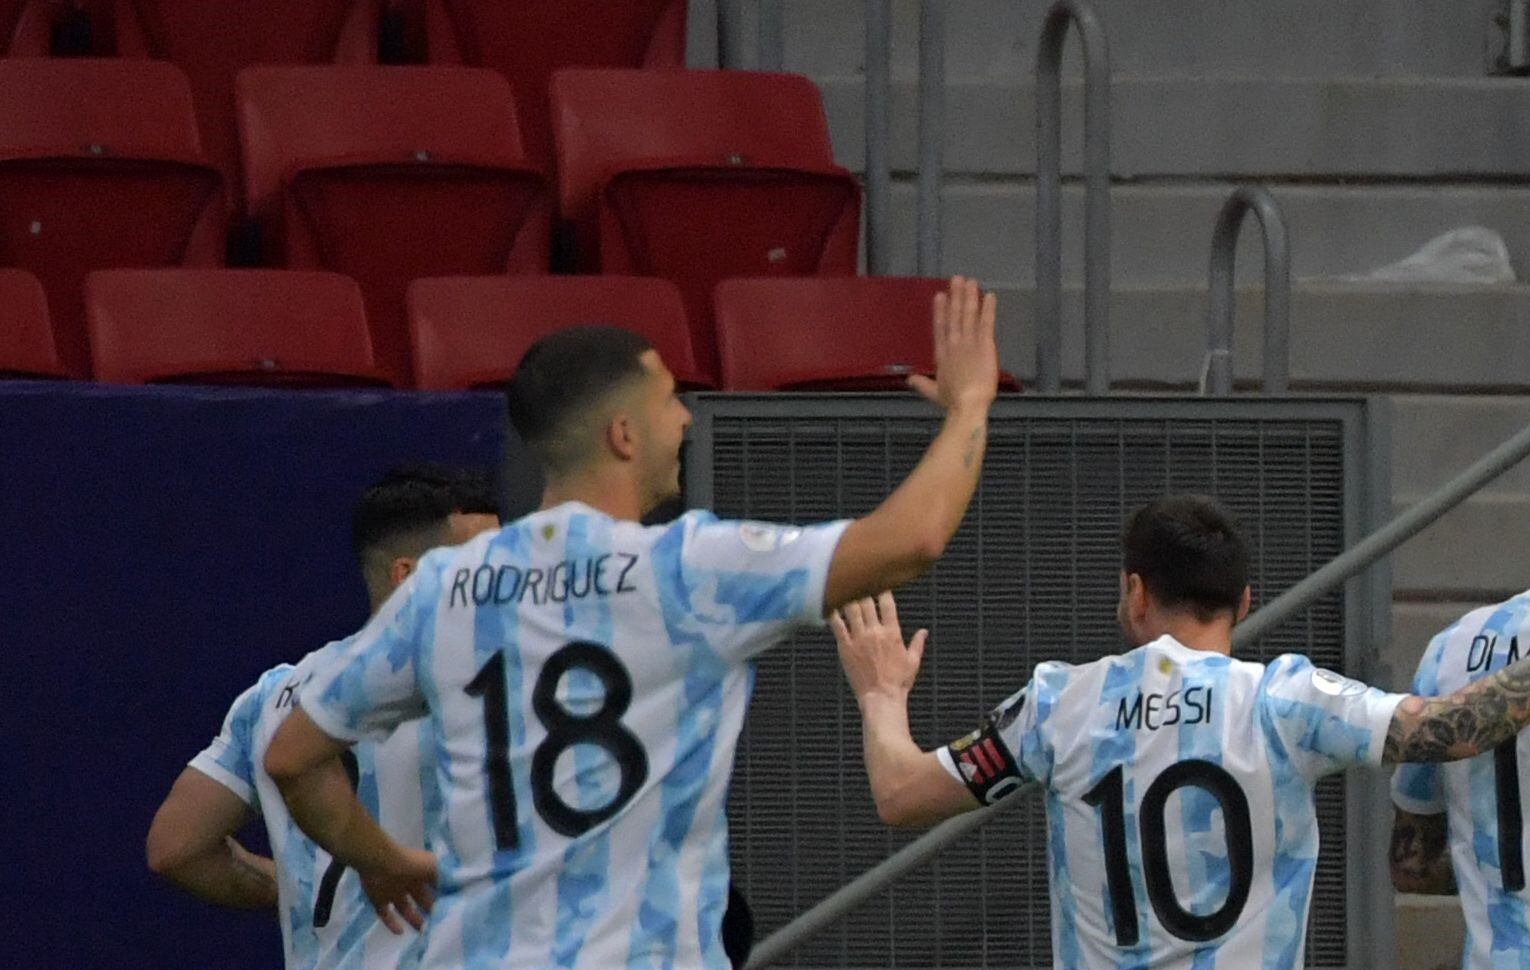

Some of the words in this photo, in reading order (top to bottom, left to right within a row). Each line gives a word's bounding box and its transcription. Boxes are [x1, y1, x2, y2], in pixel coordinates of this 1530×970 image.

[450, 552, 640, 608] RODRIGUEZ
[1466, 636, 1497, 672] DI
[1115, 687, 1212, 731] MESSI
[463, 640, 649, 851] 18
[1081, 758, 1254, 946] 10
